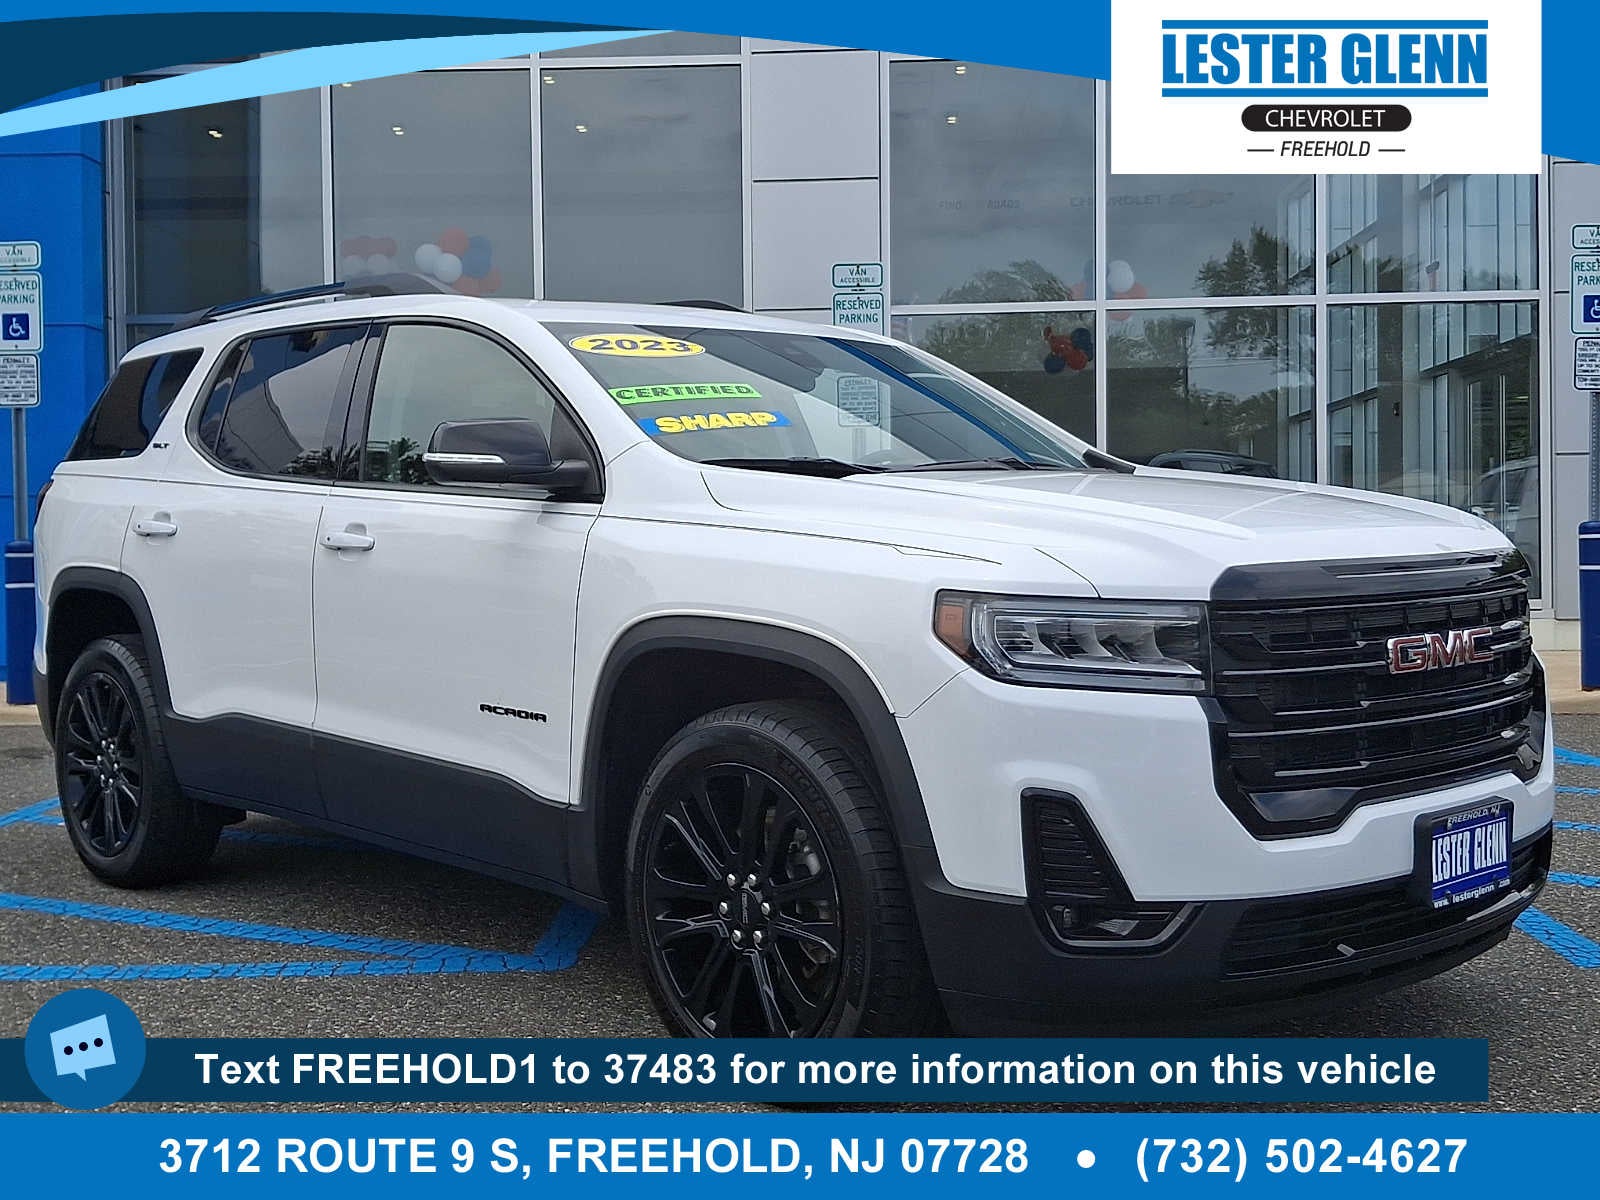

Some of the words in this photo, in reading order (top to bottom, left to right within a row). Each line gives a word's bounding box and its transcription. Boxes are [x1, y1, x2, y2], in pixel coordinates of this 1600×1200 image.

[849, 267, 867, 276] VAN
[1574, 261, 1600, 272] RESE
[0, 280, 38, 290] ESERVED
[0, 294, 35, 304] ARKING
[836, 299, 881, 310] RESERVED
[839, 313, 879, 324] PARKING
[588, 338, 691, 352] 2023
[616, 384, 752, 400] CERTIFIED
[655, 411, 777, 433] SHARP
[1387, 627, 1494, 675] GMC
[480, 703, 547, 723] ACADIA
[1432, 831, 1470, 884] LESTER
[1474, 821, 1507, 870] GLENN
